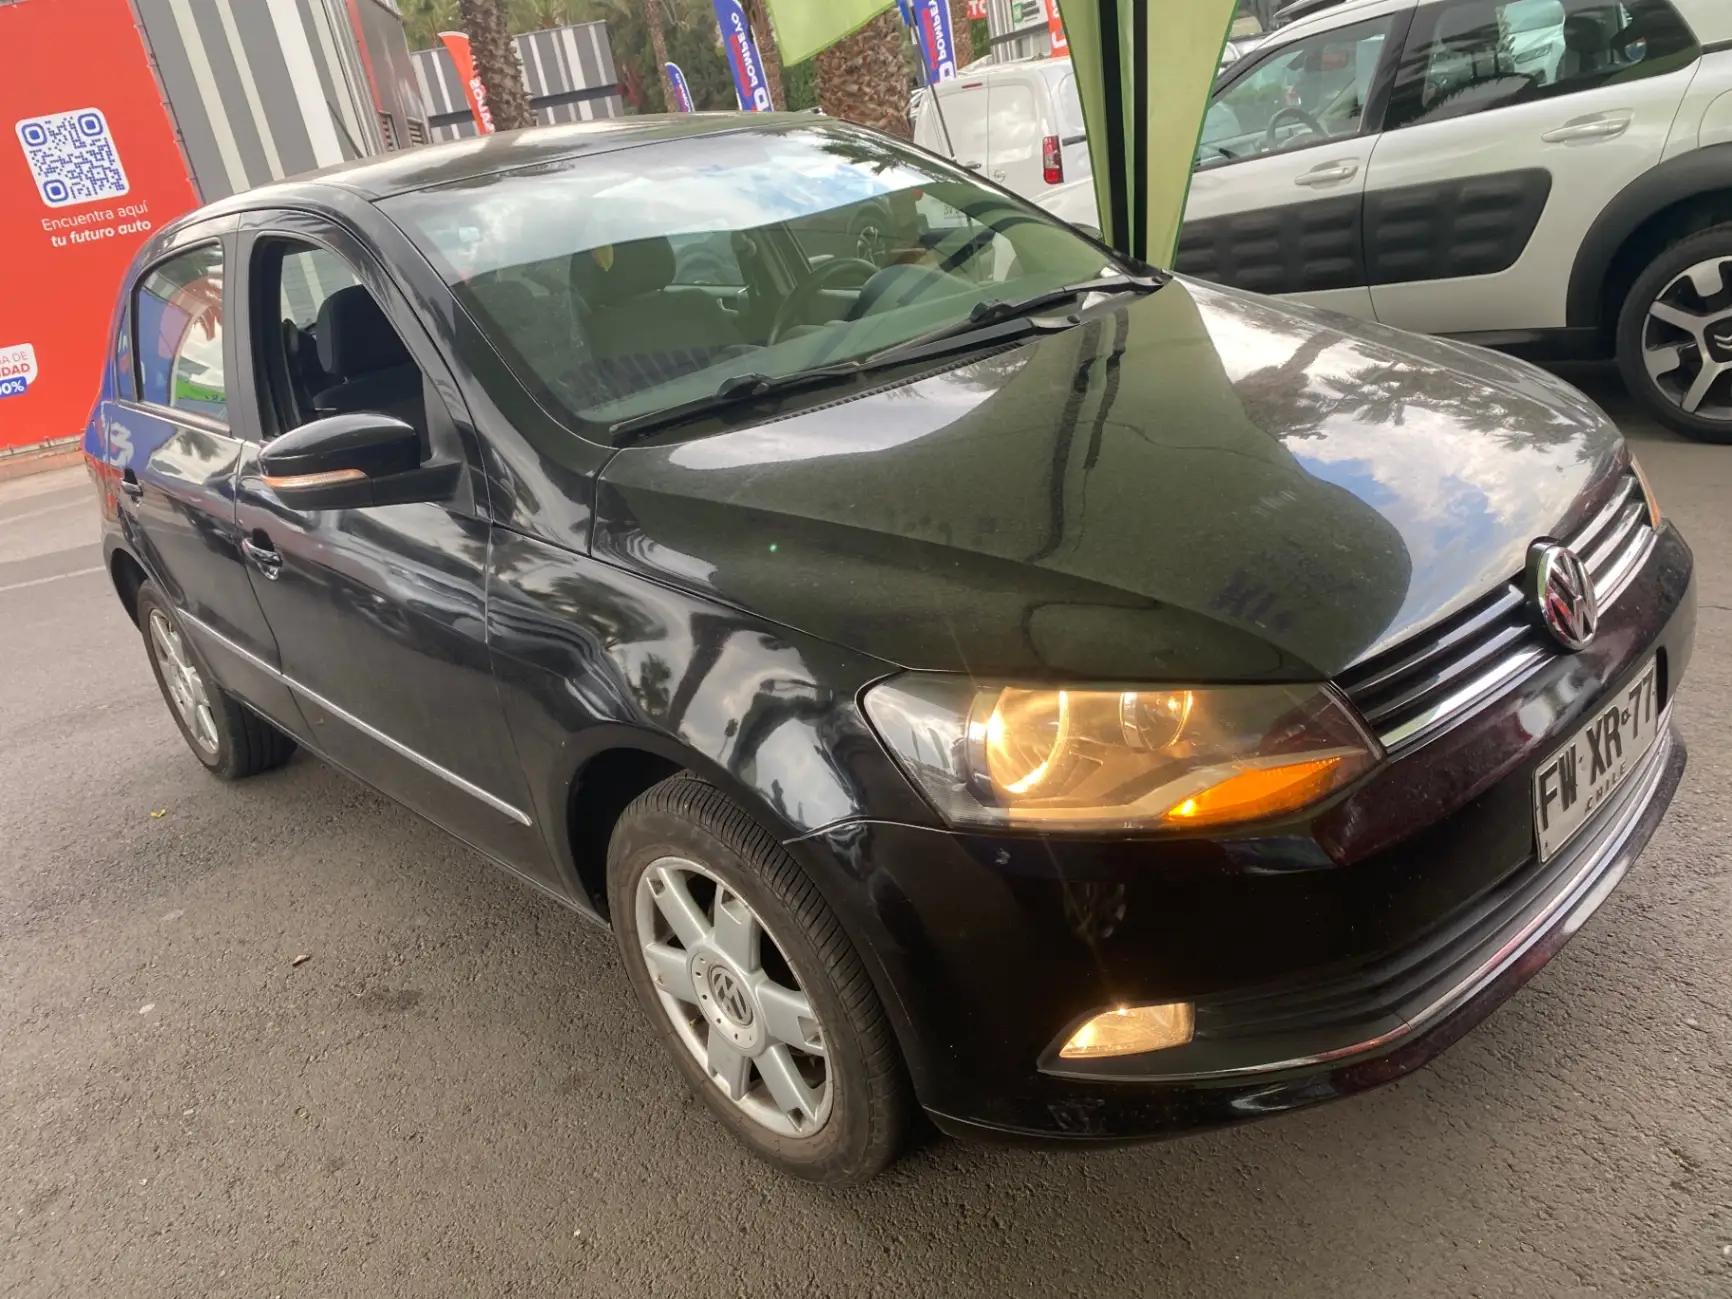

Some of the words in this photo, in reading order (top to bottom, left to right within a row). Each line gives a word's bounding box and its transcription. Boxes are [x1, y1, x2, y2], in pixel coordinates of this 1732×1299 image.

[41, 209, 115, 231] Encuentra
[117, 200, 148, 218] aquí
[51, 235, 67, 248] tu
[70, 227, 115, 244] futuro
[118, 220, 151, 234] auto
[12, 351, 28, 362] DE
